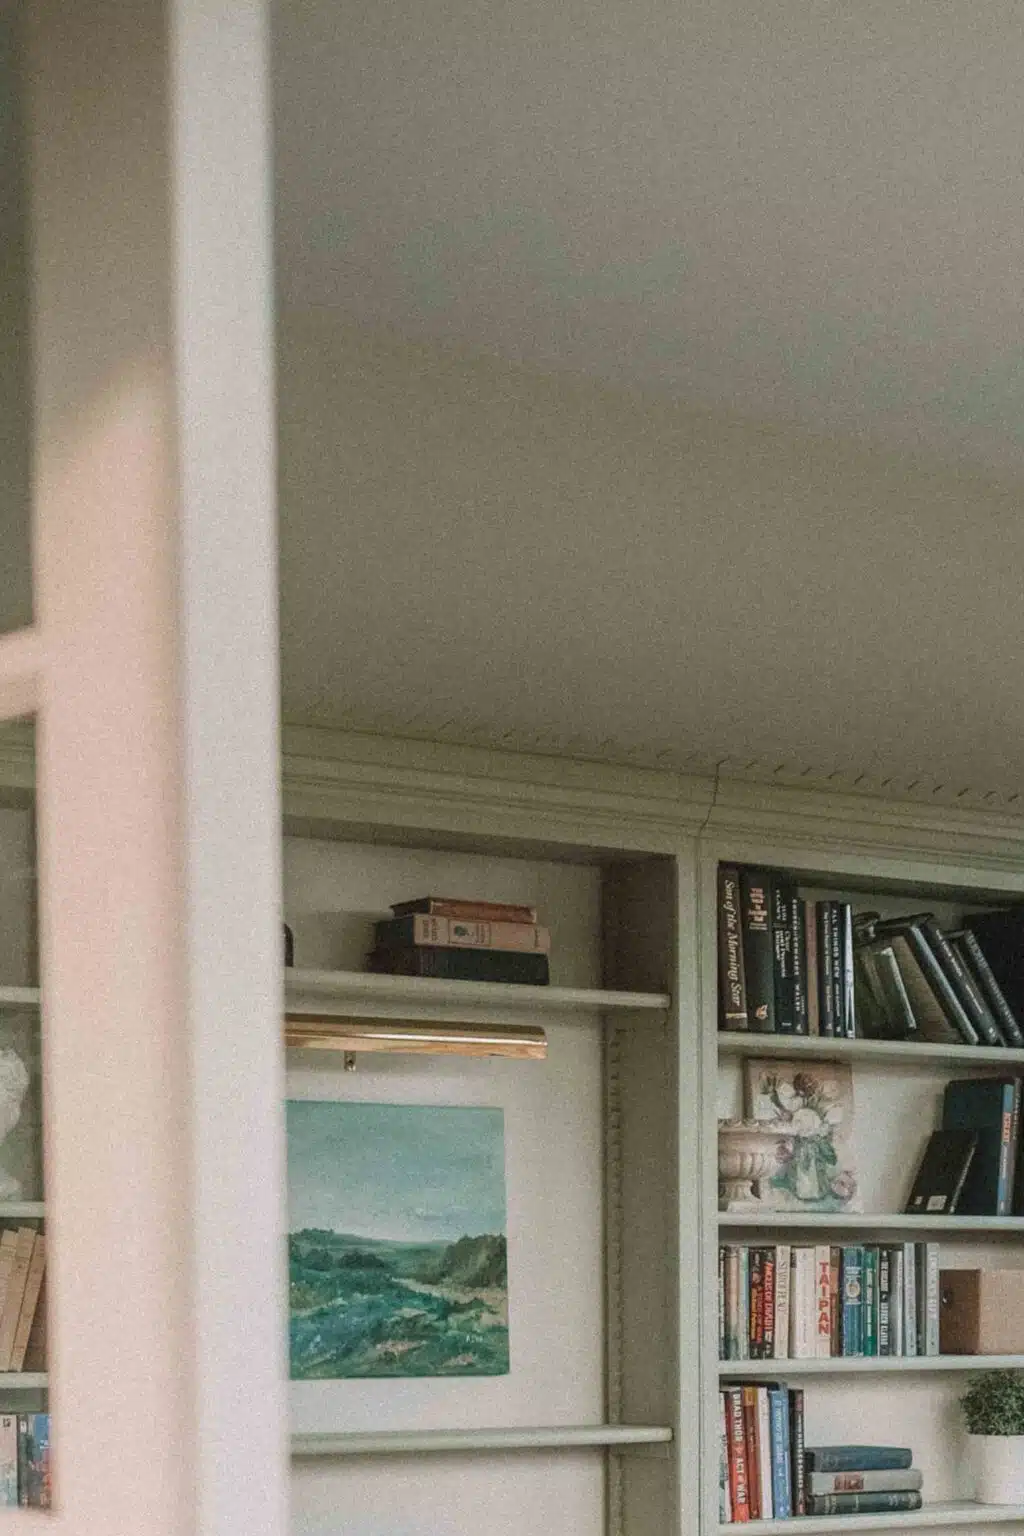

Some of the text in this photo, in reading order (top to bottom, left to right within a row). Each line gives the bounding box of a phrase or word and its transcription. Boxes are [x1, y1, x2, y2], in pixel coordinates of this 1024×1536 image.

[723, 879, 742, 1006] Son of the Morning Star
[733, 1393, 742, 1417] BRAD
[734, 1418, 743, 1442] THOR
[735, 1456, 745, 1474] ACT
[736, 1483, 746, 1504] WAR
